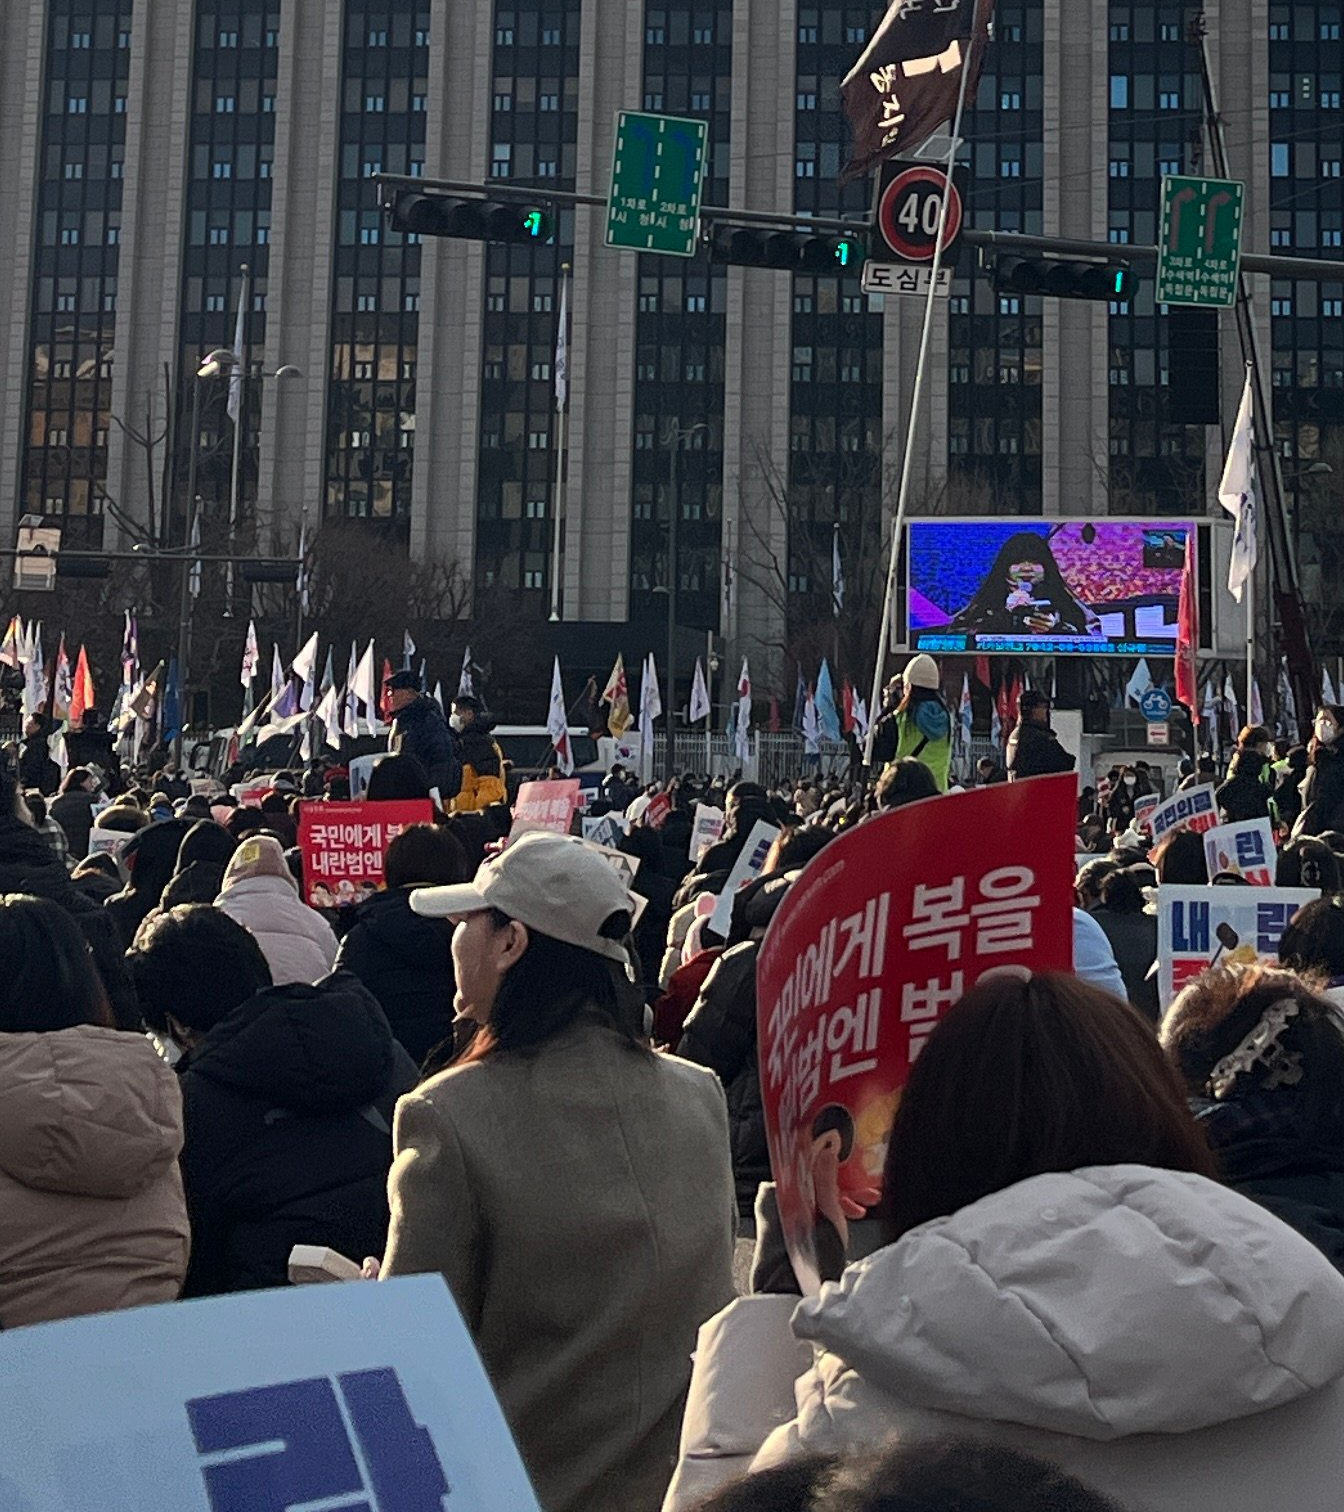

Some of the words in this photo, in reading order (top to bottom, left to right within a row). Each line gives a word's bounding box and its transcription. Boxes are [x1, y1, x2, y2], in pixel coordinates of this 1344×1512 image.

[898, 193, 944, 236] 40
[868, 268, 950, 292] 도심부
[310, 824, 382, 848] 국민에게
[311, 850, 383, 875] 내란범엔
[902, 865, 1040, 961] 복을
